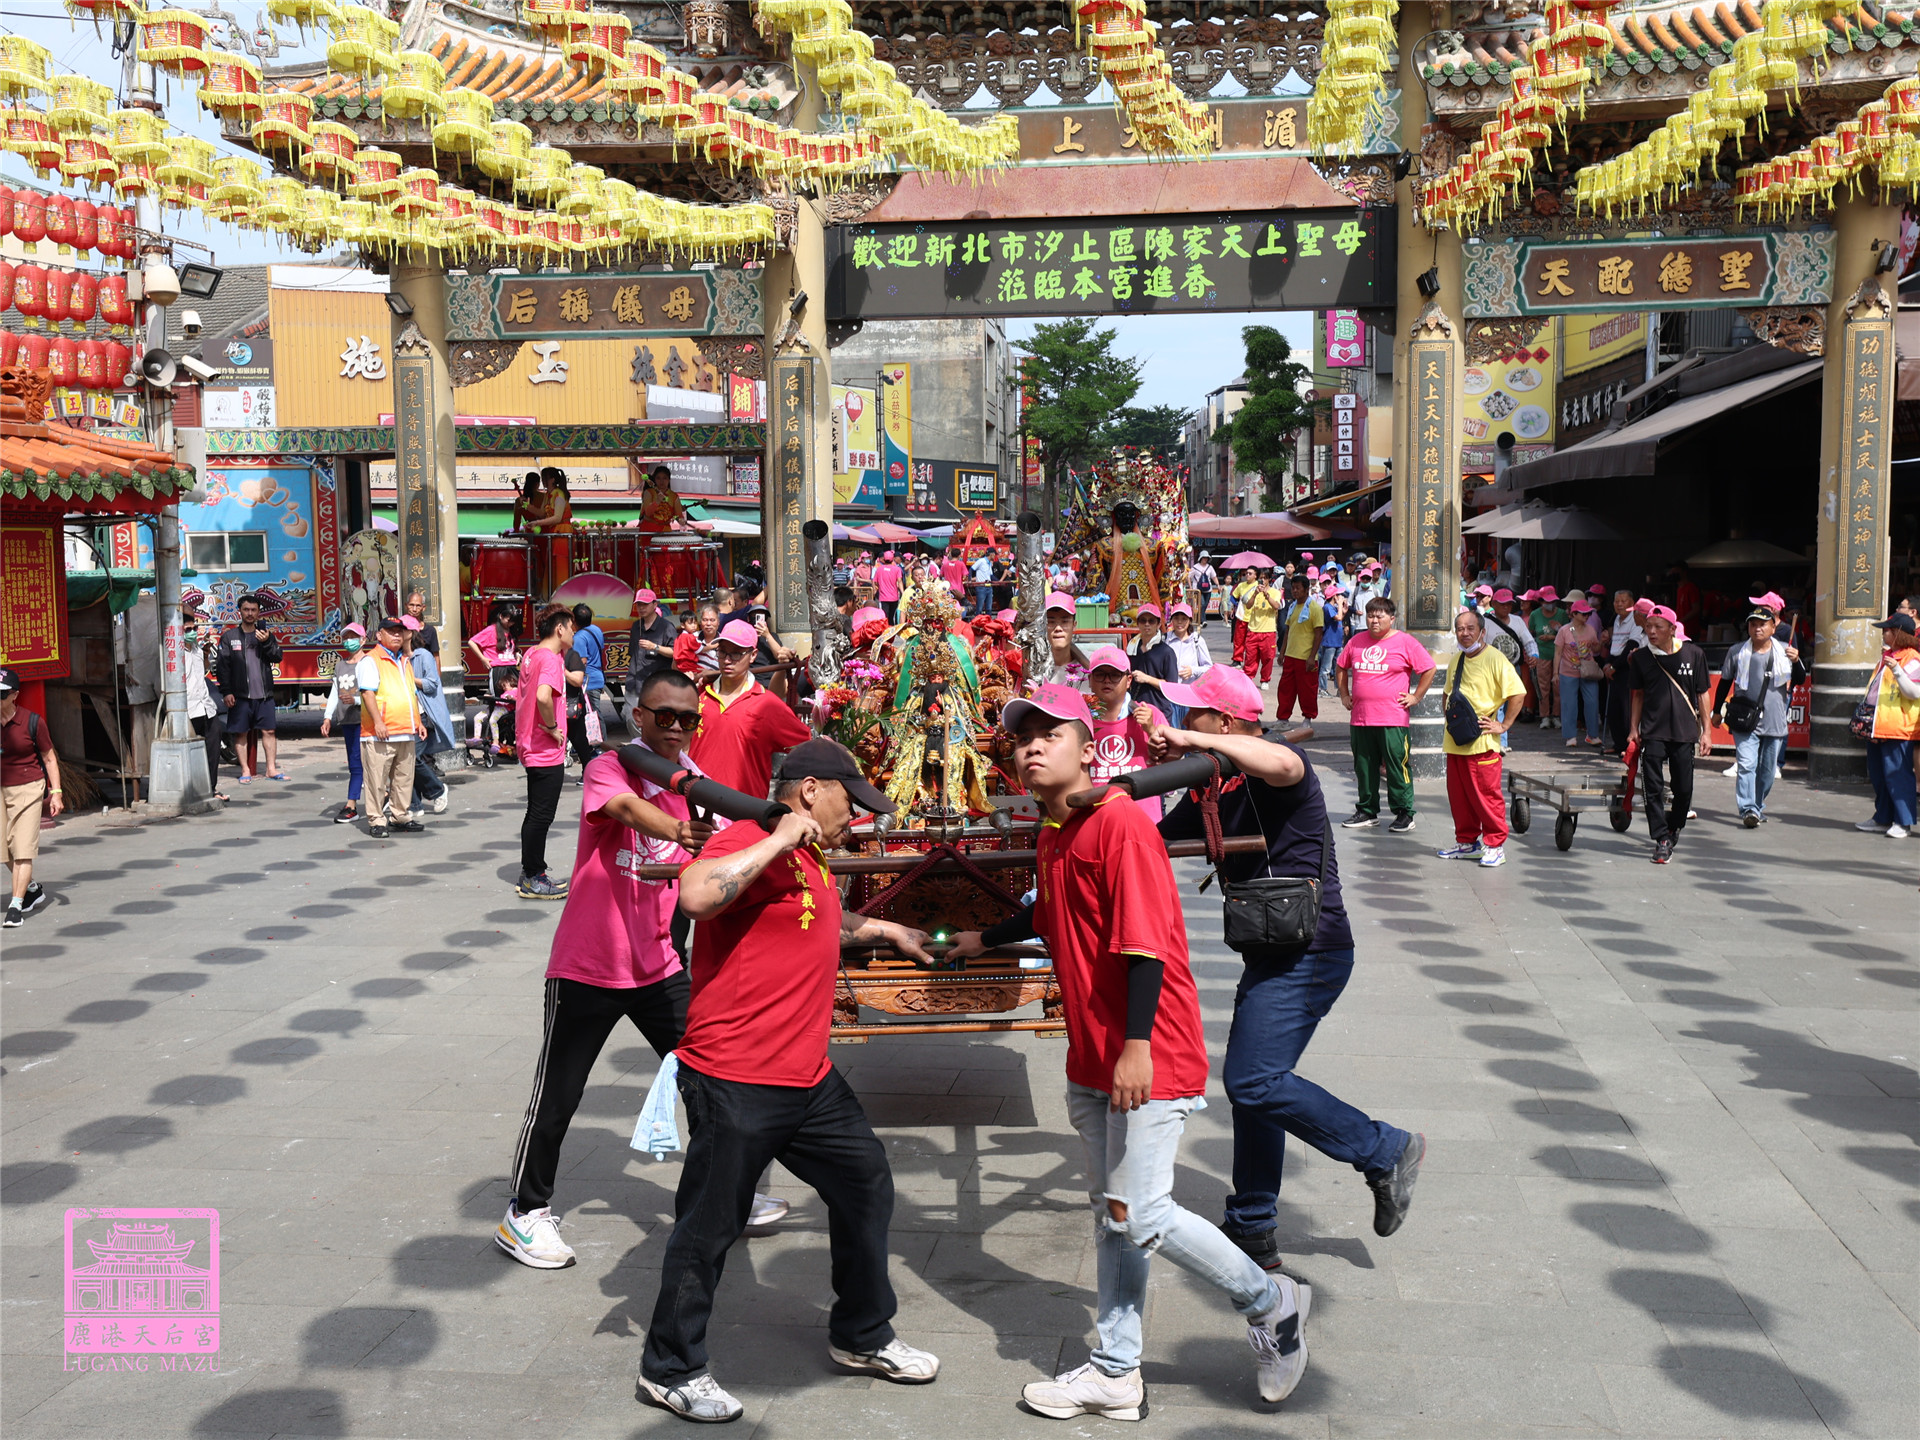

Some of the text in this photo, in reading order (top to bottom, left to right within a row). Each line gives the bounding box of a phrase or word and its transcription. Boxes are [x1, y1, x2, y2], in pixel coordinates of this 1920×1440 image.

[852, 221, 1367, 270] 歡迎新北市汐止區陳家天上聖母
[998, 263, 1215, 302] 蒞臨本宮進香
[891, 390, 900, 431] 公益彩券
